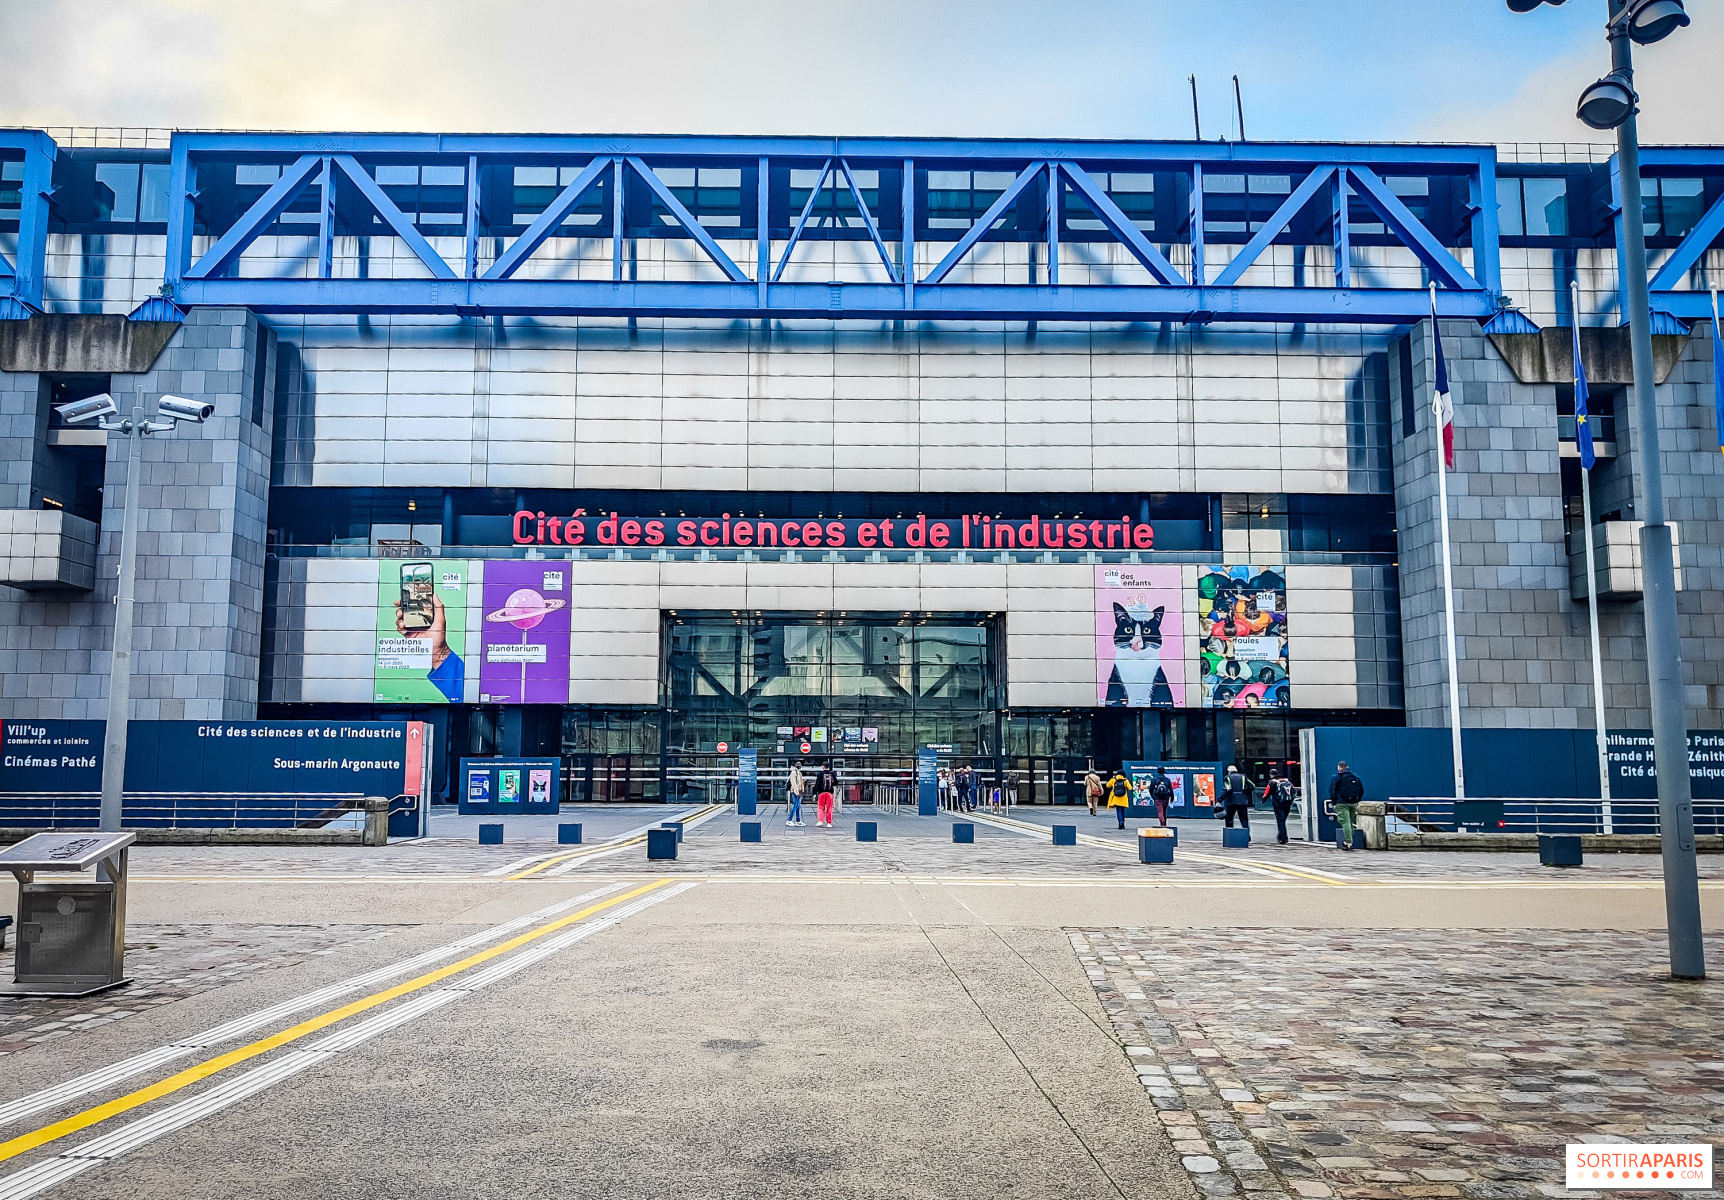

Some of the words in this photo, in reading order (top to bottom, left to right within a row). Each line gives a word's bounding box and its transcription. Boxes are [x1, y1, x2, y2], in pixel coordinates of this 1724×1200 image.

[512, 508, 586, 545] Cité
[597, 511, 666, 545] des
[677, 512, 847, 546] sciences
[858, 518, 894, 547] et
[906, 514, 950, 547] de
[961, 513, 1154, 548] l'industrie
[442, 572, 459, 581] cité
[543, 570, 560, 579] cité
[1256, 593, 1273, 601] cité
[378, 637, 422, 645] évolutions
[488, 644, 539, 653] planétarium
[7, 725, 47, 739] Vill'up
[198, 725, 223, 737] Cité
[226, 726, 248, 737] des
[250, 727, 303, 738] sciences
[307, 728, 320, 738] et
[323, 727, 337, 738] de
[340, 727, 401, 738] l'industrie
[63, 737, 89, 745] loisirs
[1694, 735, 1724, 746] Paris
[4, 755, 58, 767] Cinémas
[61, 755, 96, 767] Pathé
[1608, 750, 1643, 761] rande
[274, 757, 338, 769] Sous-marin
[340, 758, 400, 772] Argonaute
[1620, 765, 1644, 777] Cité
